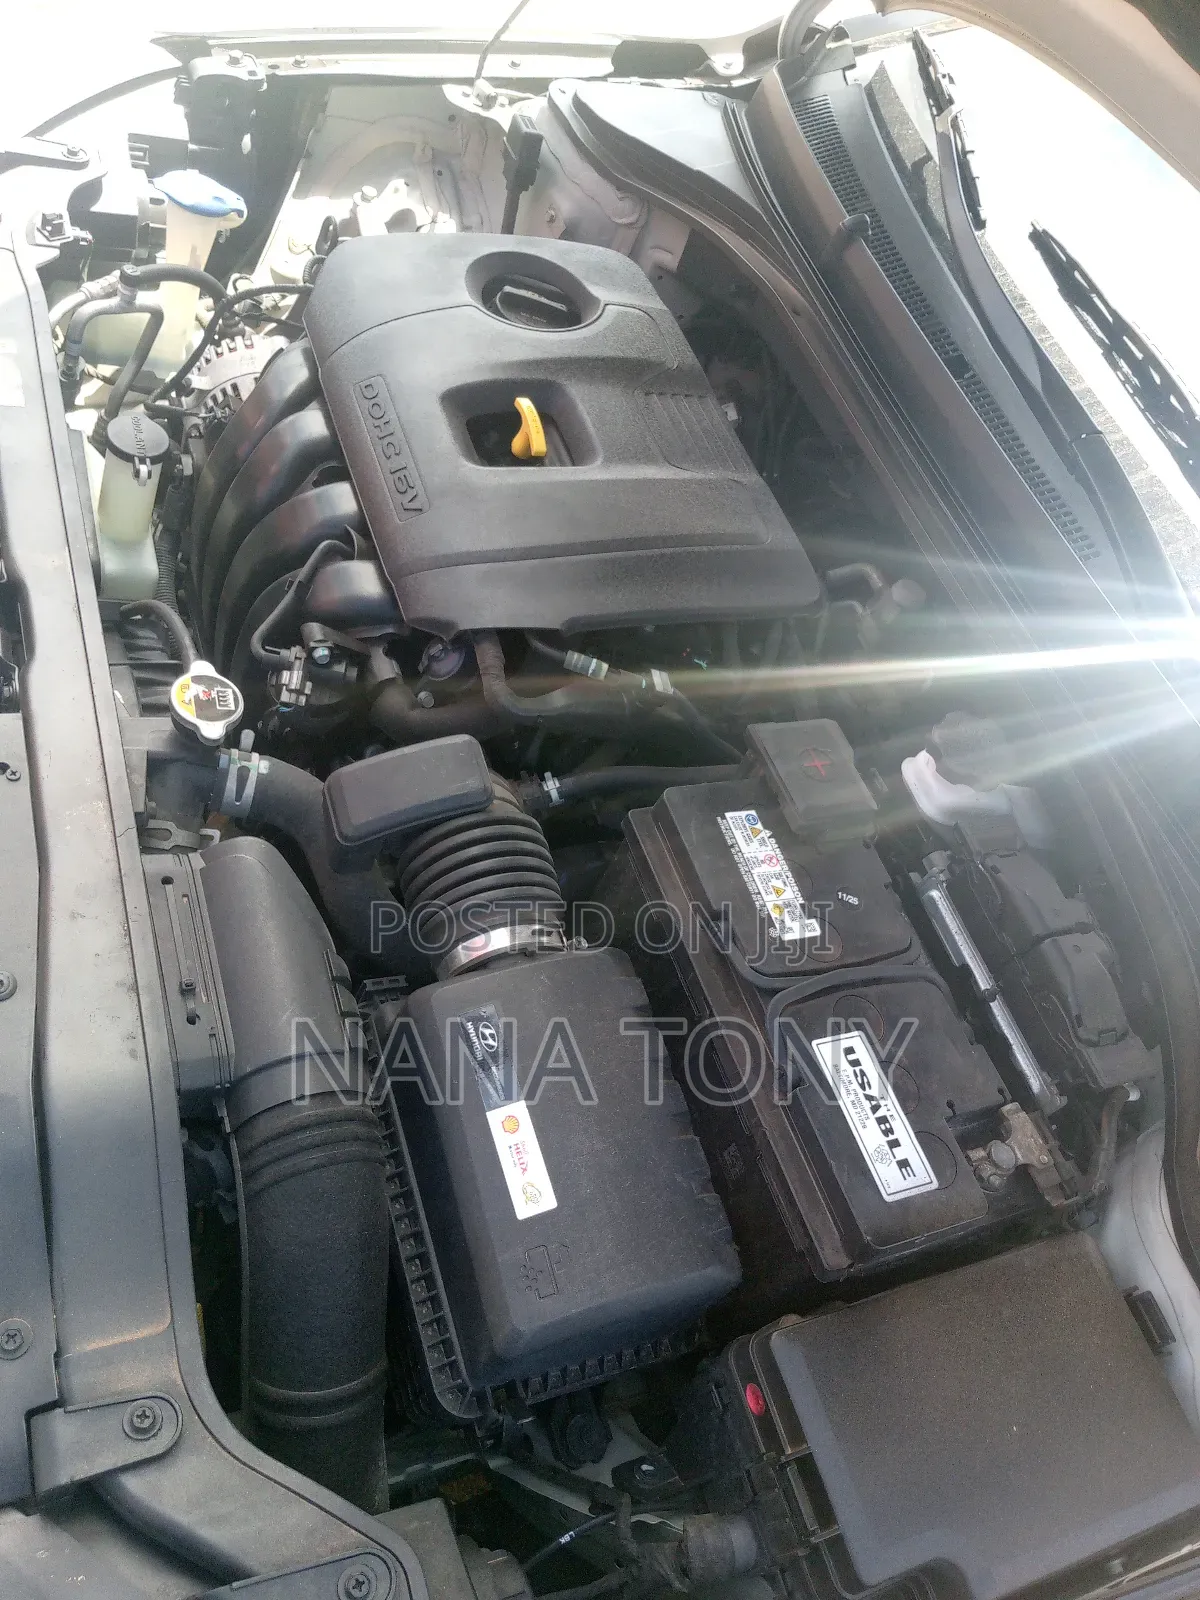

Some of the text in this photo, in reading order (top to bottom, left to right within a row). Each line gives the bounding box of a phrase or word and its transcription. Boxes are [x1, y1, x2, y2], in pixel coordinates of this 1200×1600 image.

[389, 465, 423, 512] 16V
[769, 837, 805, 904] DANGER/POISON
[837, 890, 859, 906] 11/25
[466, 1021, 483, 1061] HYUNDAI
[843, 1046, 917, 1181] USABLE
[851, 1088, 870, 1121] PRODUCTS
[879, 1094, 897, 1122] THE
[513, 1142, 528, 1175] HELIX
[559, 1531, 575, 1545] LBK
